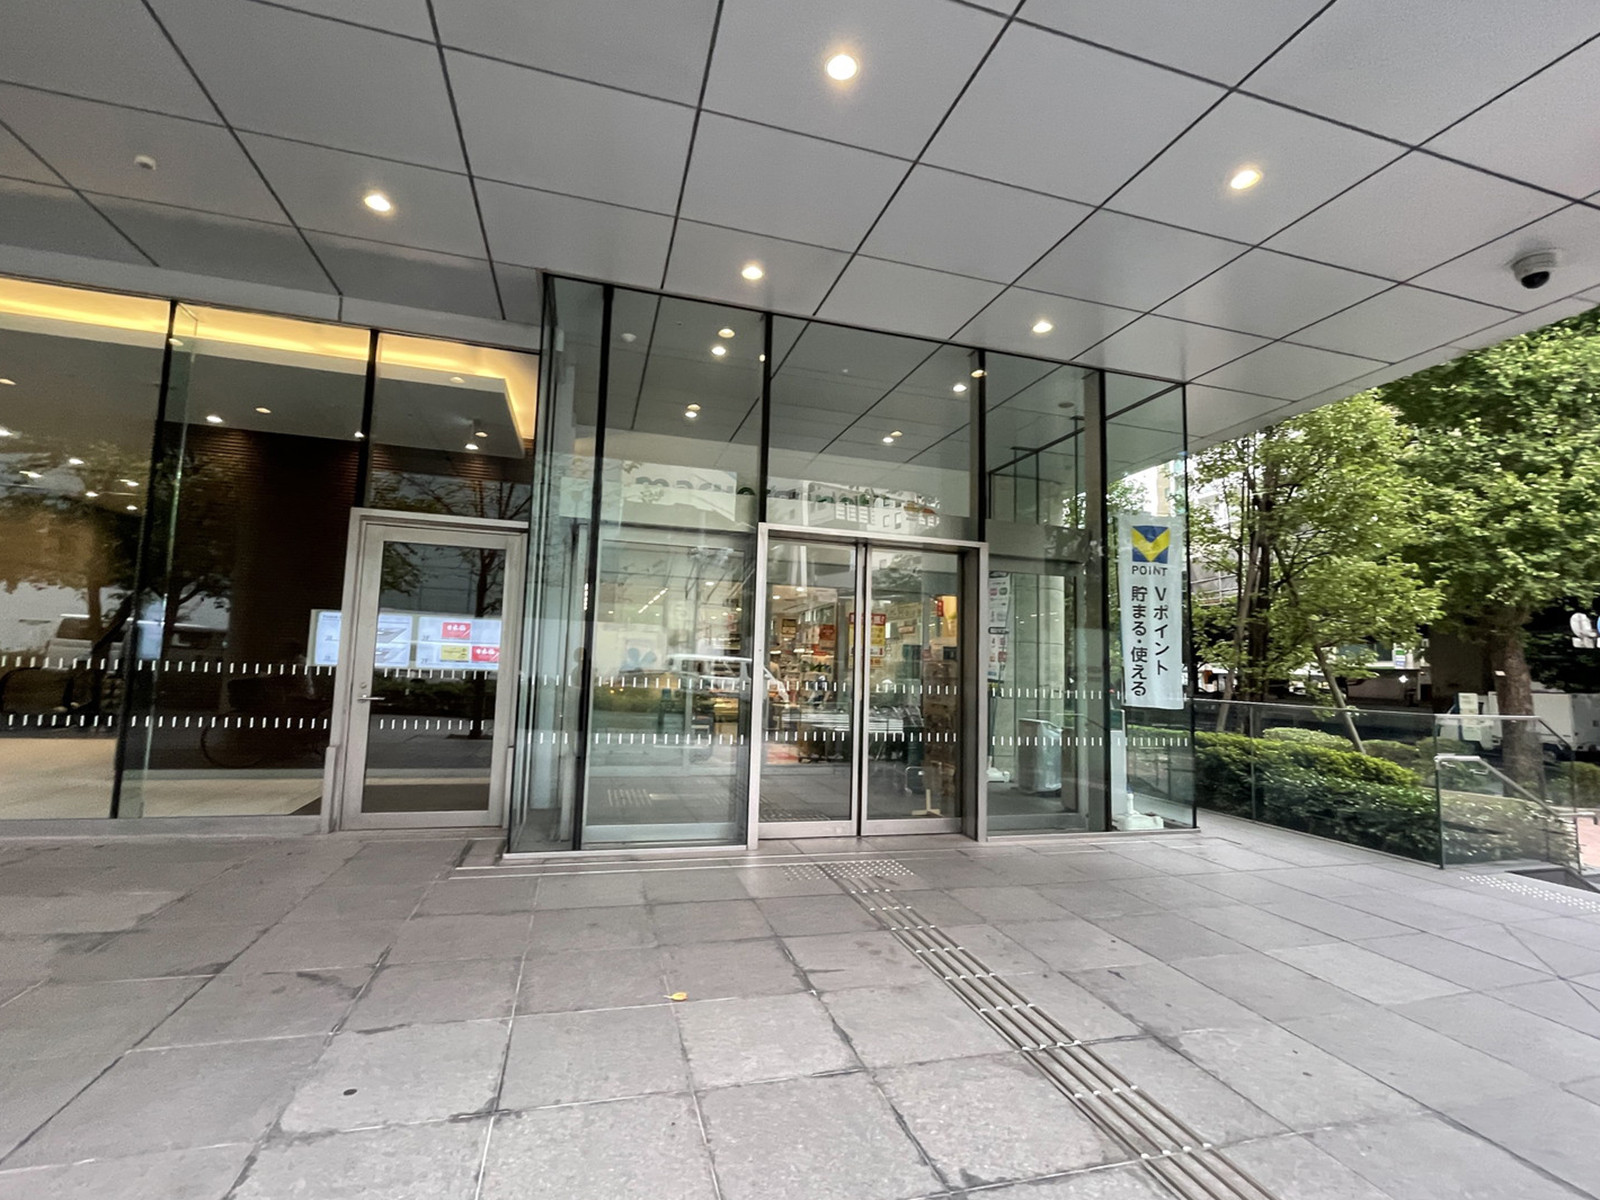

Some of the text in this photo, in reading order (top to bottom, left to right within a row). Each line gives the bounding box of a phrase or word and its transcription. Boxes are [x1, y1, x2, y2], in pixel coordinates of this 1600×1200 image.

[1131, 565, 1168, 577] POINT
[1131, 586, 1148, 697] 貯まる・使える
[1154, 587, 1169, 675] Vポイント
